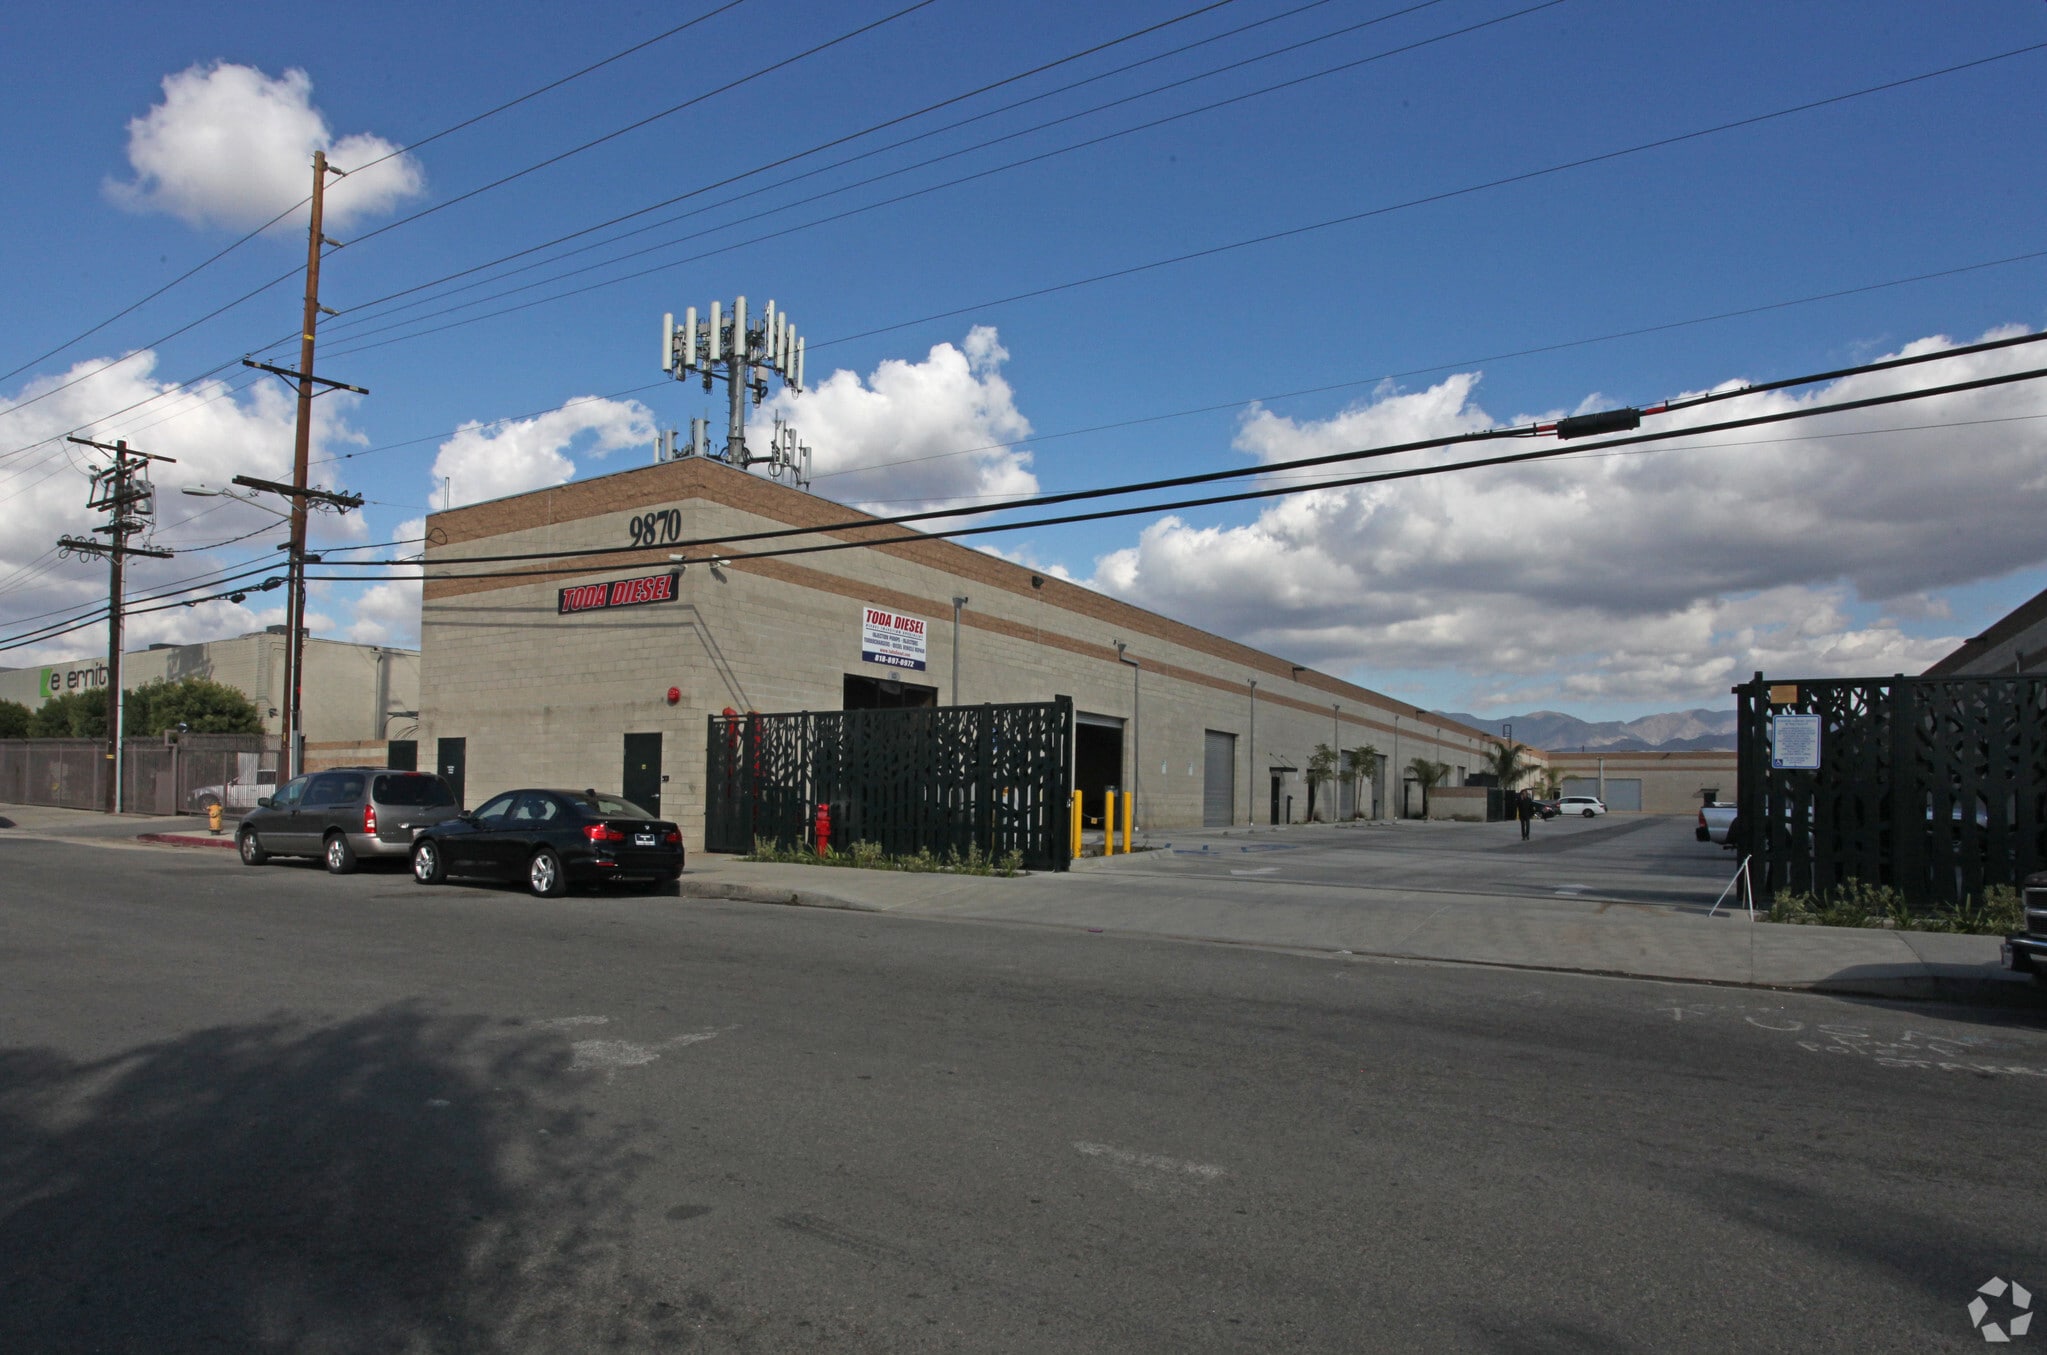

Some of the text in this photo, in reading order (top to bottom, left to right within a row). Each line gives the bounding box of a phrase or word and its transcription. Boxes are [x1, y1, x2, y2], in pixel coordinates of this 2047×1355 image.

[629, 508, 681, 547] 9870
[562, 575, 672, 612] TODA DIESEL
[866, 609, 892, 628] TODA
[893, 616, 924, 635] DIESEL
[67, 661, 110, 689] ernit
